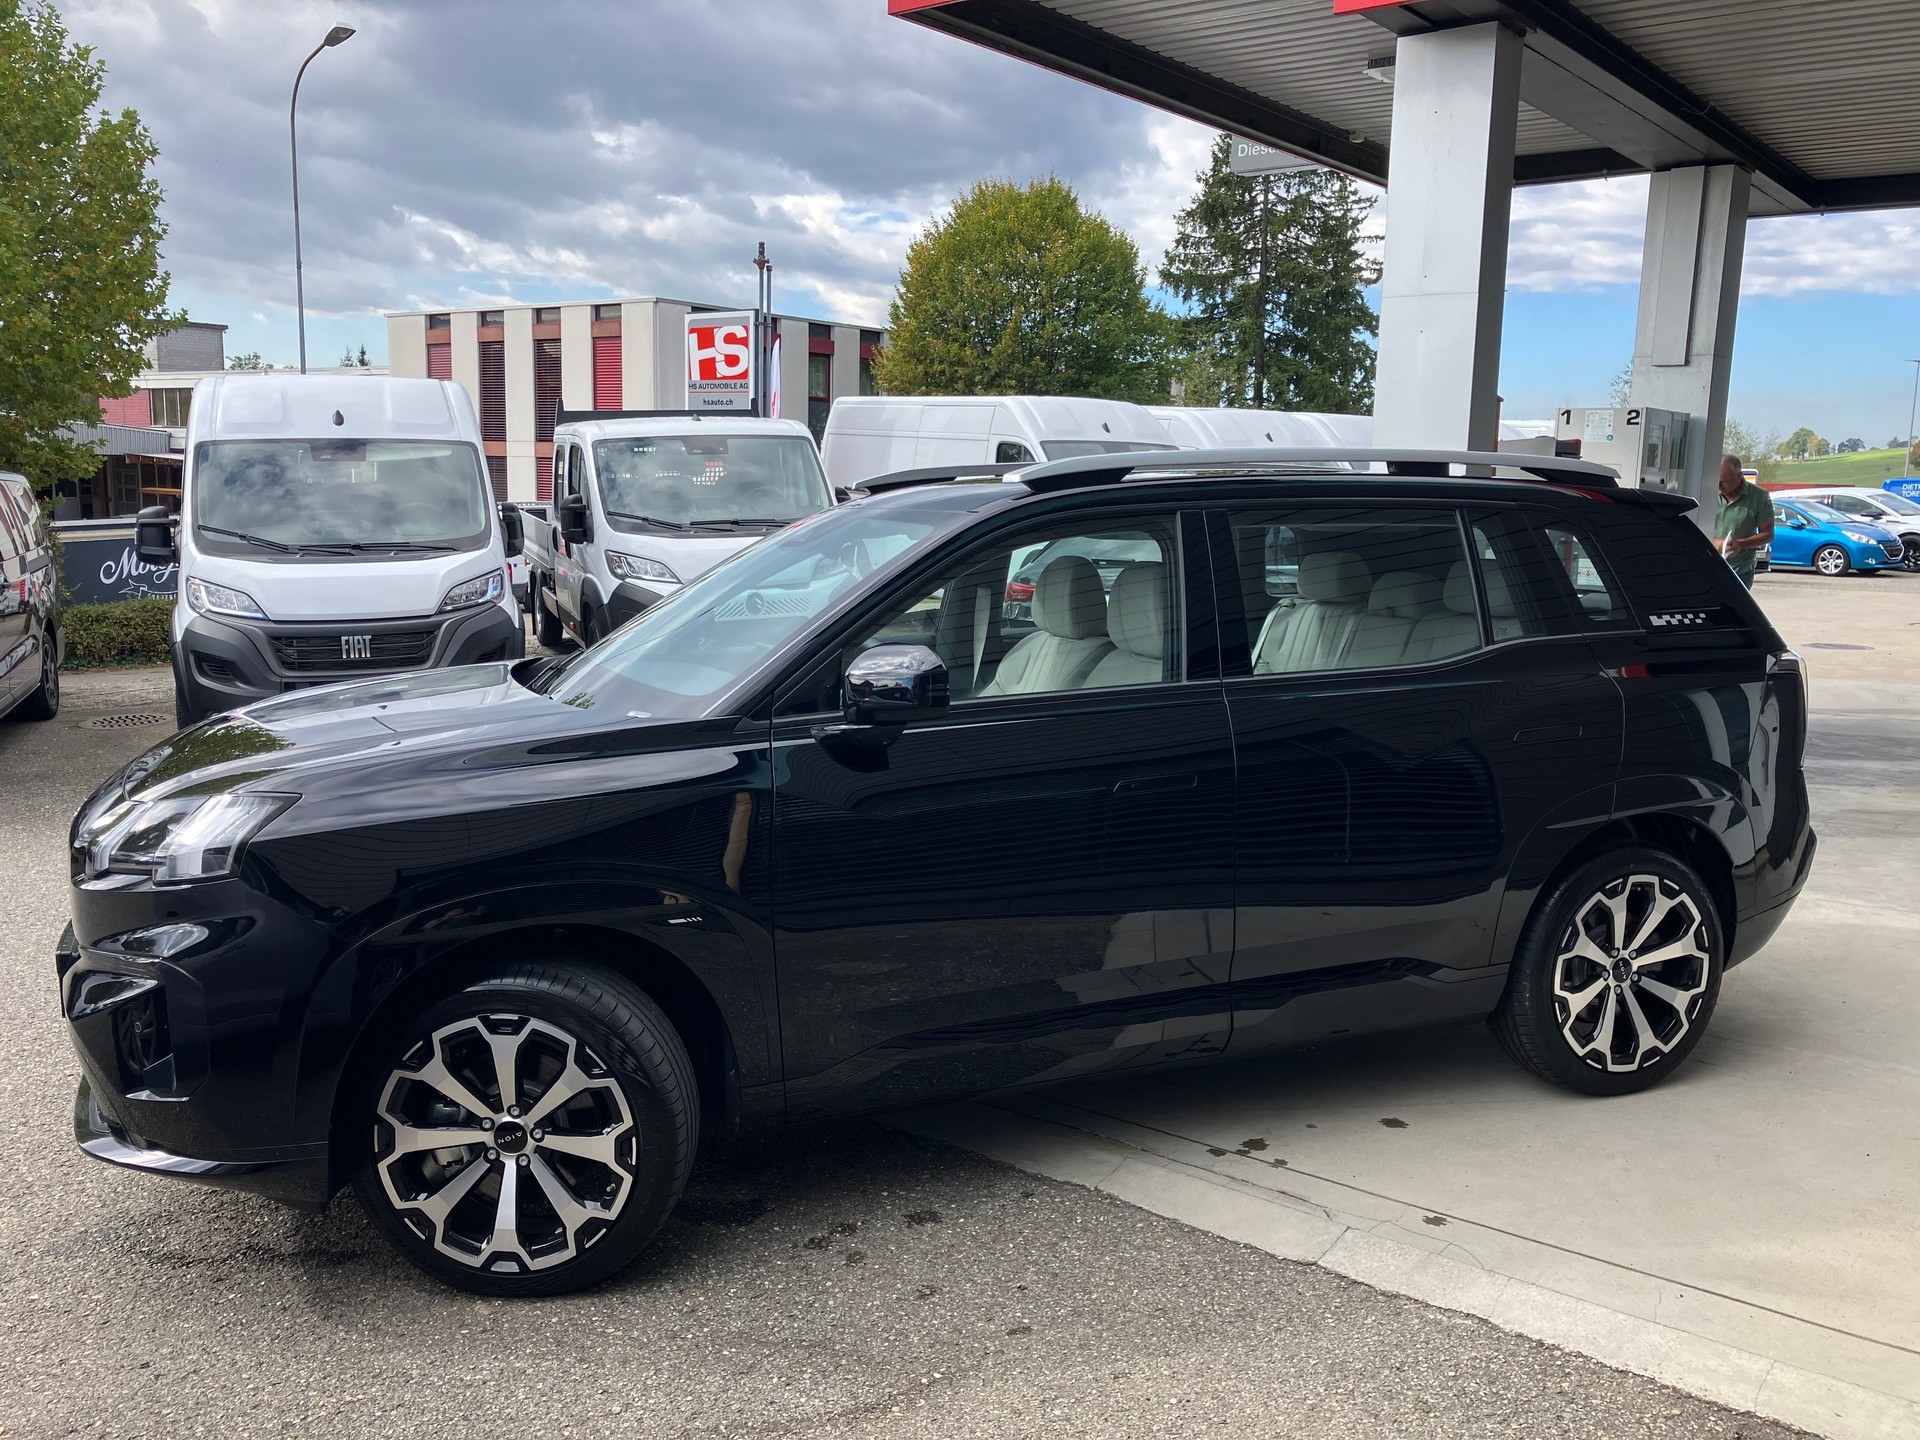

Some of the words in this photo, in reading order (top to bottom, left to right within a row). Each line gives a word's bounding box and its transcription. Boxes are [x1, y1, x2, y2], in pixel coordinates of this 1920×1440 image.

[688, 325, 748, 380] HS
[698, 382, 738, 390] AUTOMOBILE
[702, 398, 734, 406] hsauto.ch
[1560, 409, 1571, 425] 1
[1626, 409, 1640, 425] 2
[341, 635, 372, 659] FIAT
[497, 1131, 523, 1144] AION
